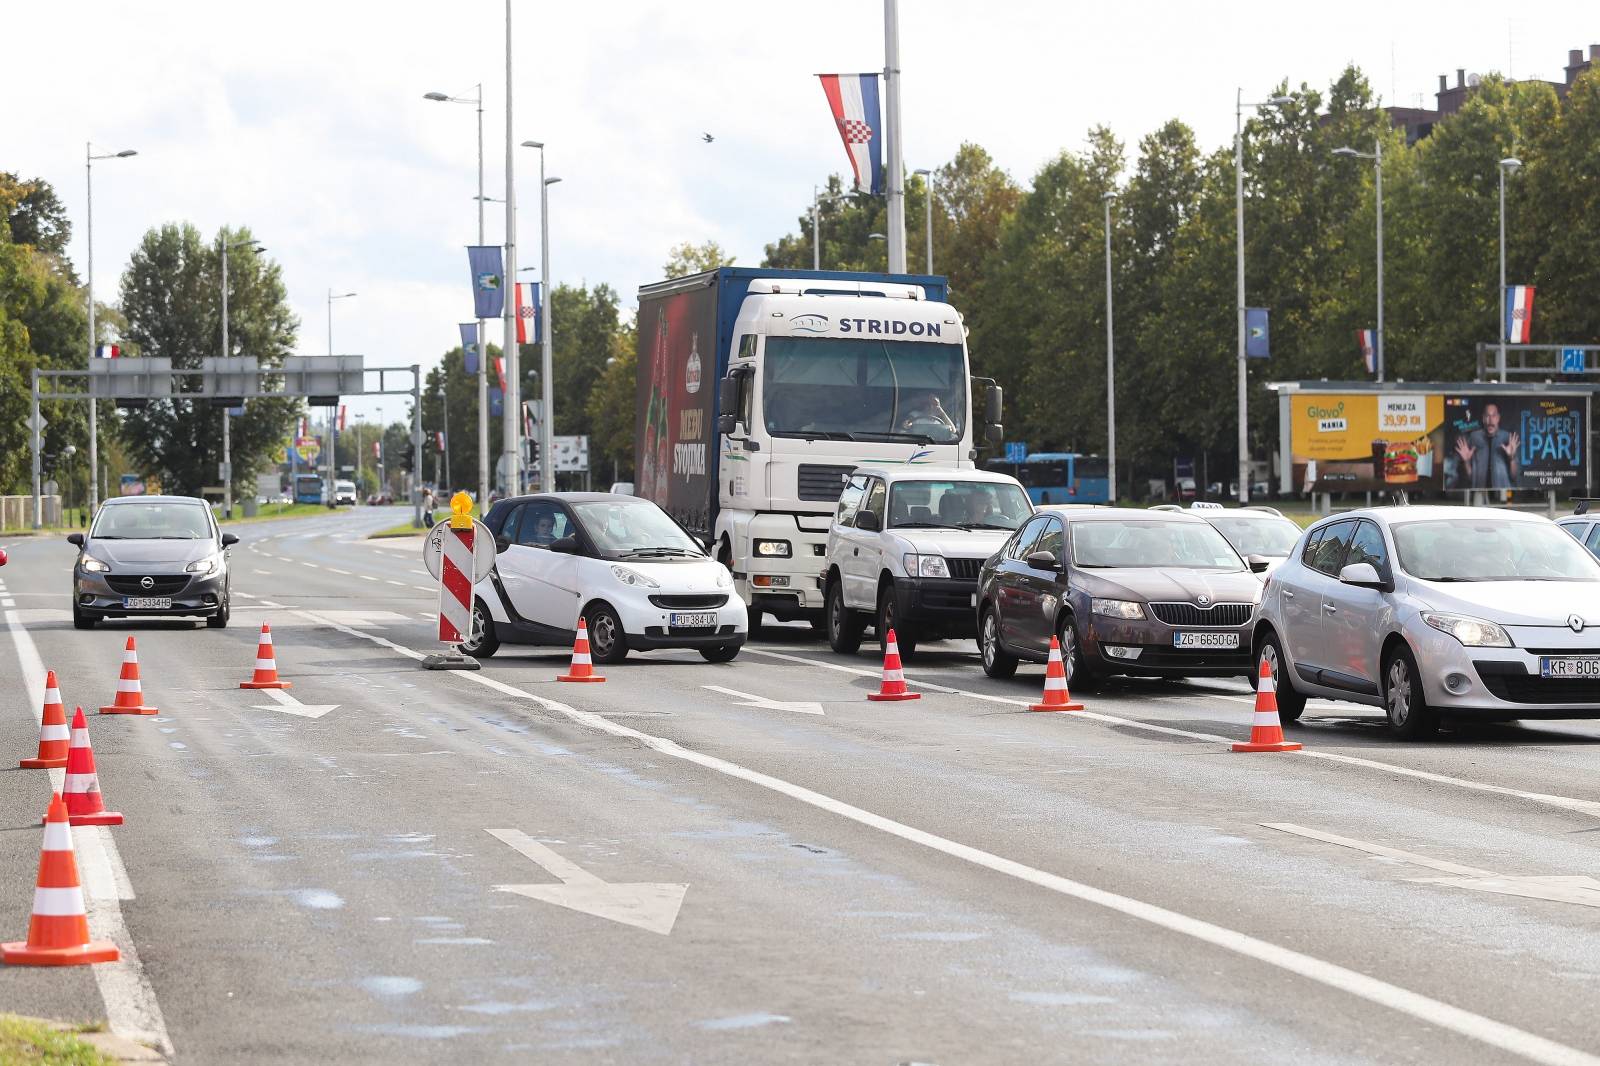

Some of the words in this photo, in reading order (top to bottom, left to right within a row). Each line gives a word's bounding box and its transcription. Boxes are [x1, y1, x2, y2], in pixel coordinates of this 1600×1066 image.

[839, 318, 941, 337] STRIDON
[1307, 405, 1340, 418] Glovo
[1408, 403, 1416, 411] ZA
[1321, 421, 1344, 430] MANIA
[1383, 414, 1407, 426] 39,99
[1529, 416, 1571, 432] SUPER
[1530, 433, 1571, 459] PAR
[673, 443, 706, 483] SVOJIMA
[1539, 477, 1545, 485] U
[676, 615, 686, 625] PU
[1182, 634, 1194, 645] ZG
[1551, 661, 1566, 675] KR
[1576, 661, 1599, 675] 806
